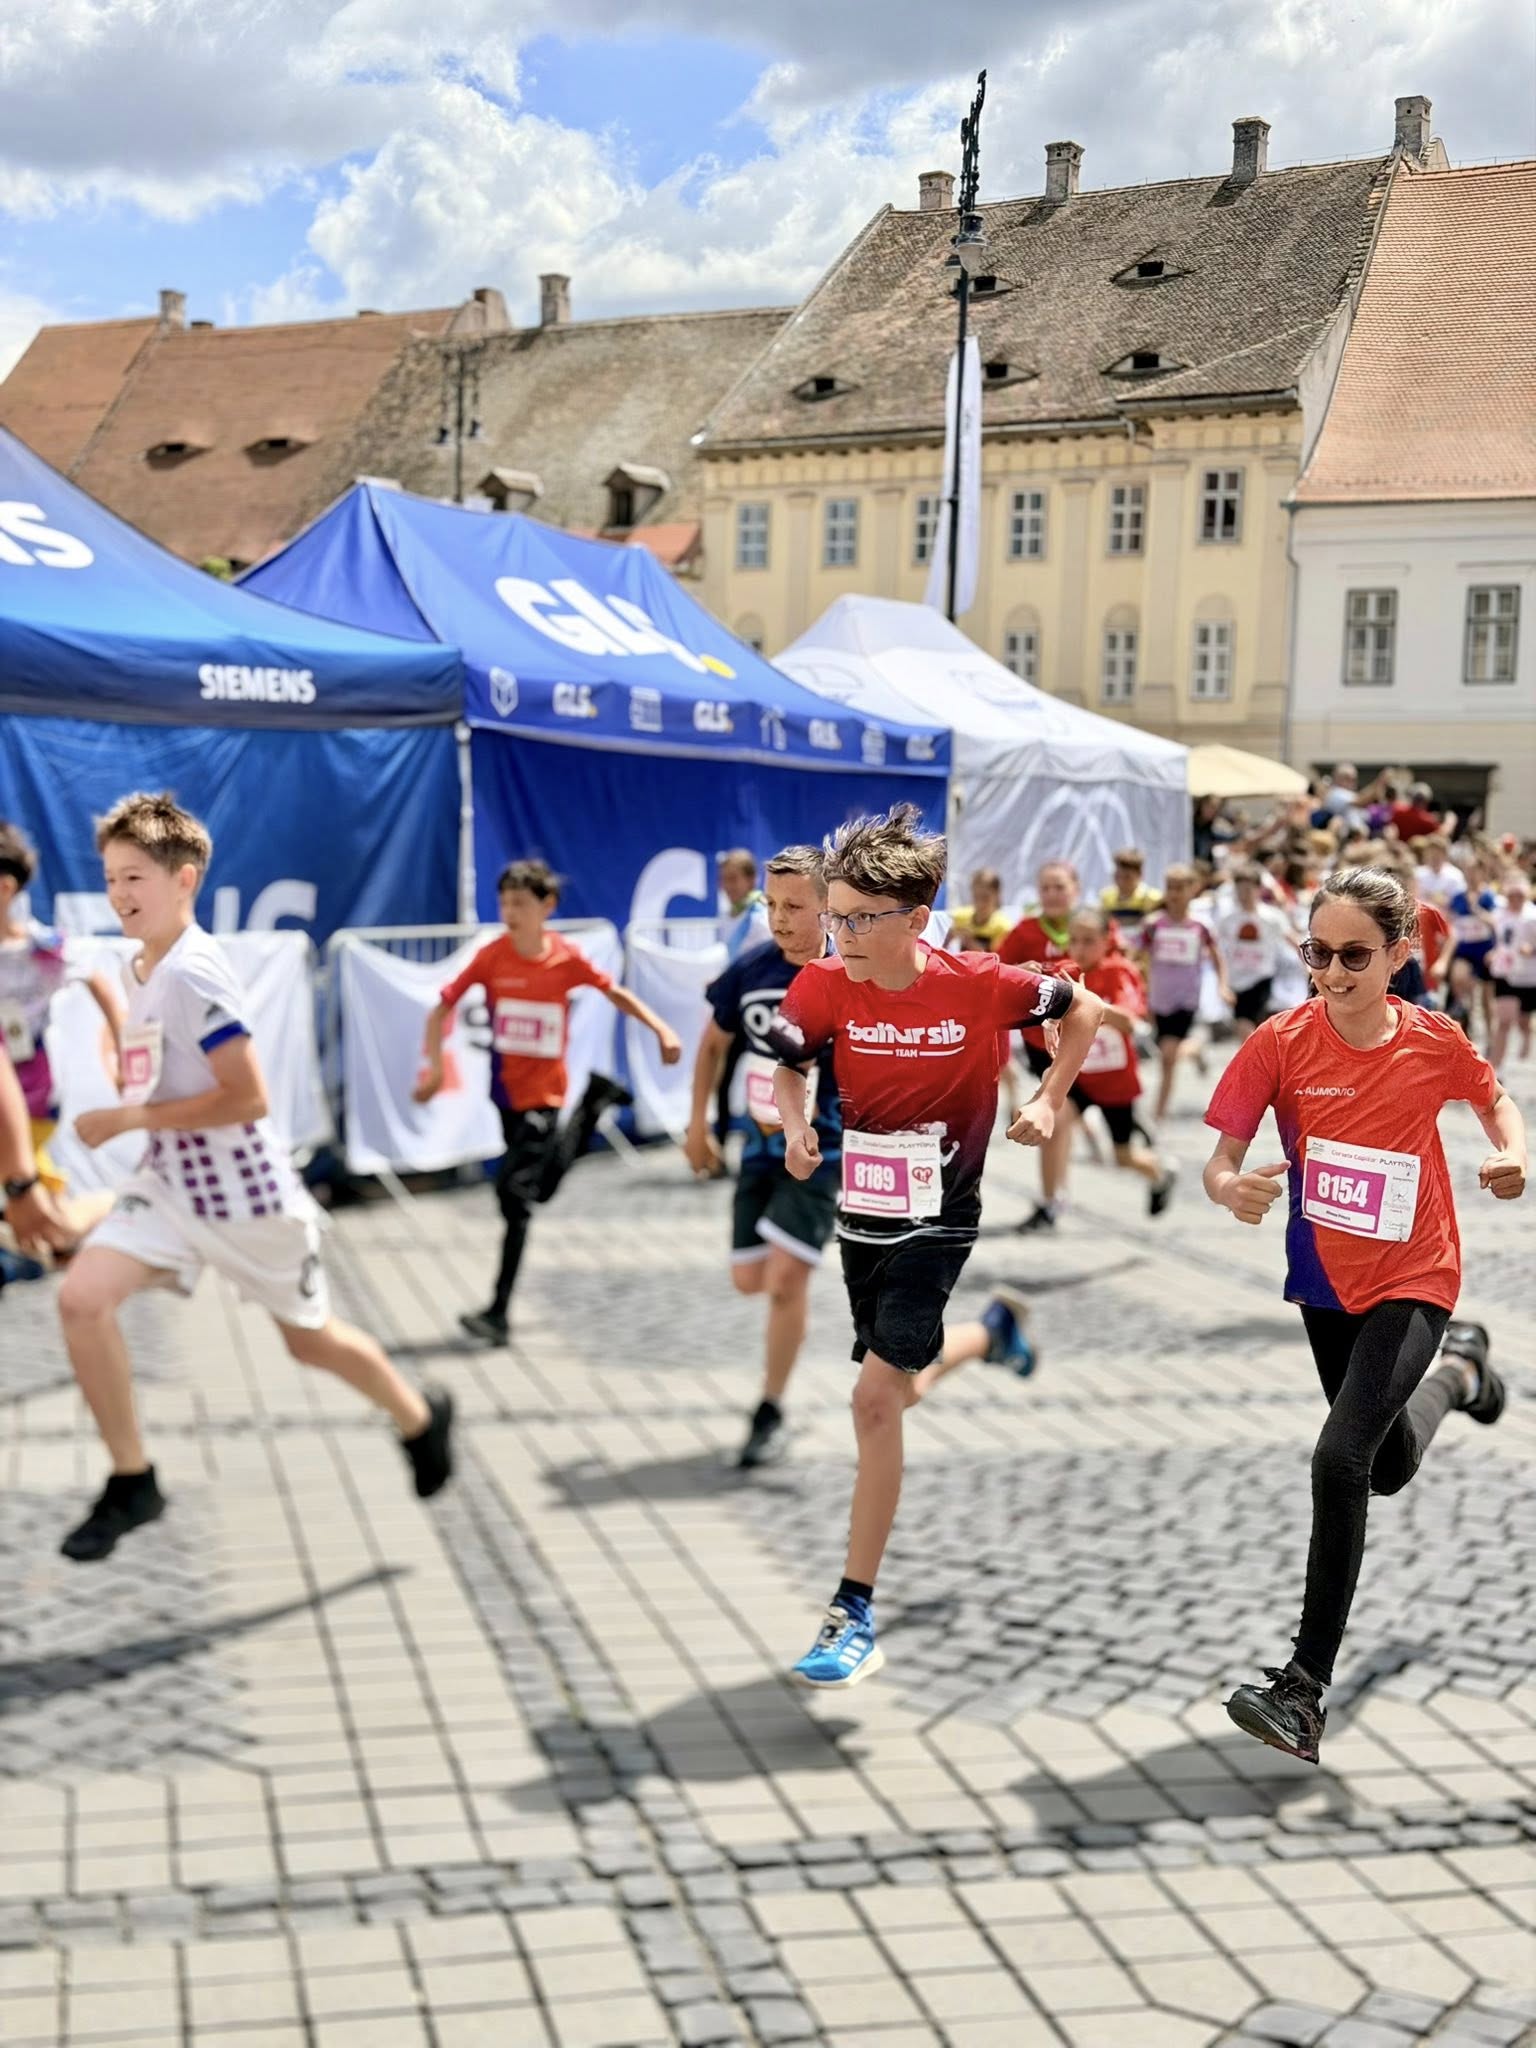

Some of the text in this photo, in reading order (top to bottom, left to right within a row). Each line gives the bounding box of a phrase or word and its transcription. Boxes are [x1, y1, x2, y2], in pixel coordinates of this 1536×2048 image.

[198, 664, 316, 704] SIEMENS
[895, 1048, 919, 1058] TEAM
[1305, 1086, 1356, 1097] AUMOVIO
[854, 1161, 896, 1192] 8189
[1317, 1171, 1370, 1208] 8154
